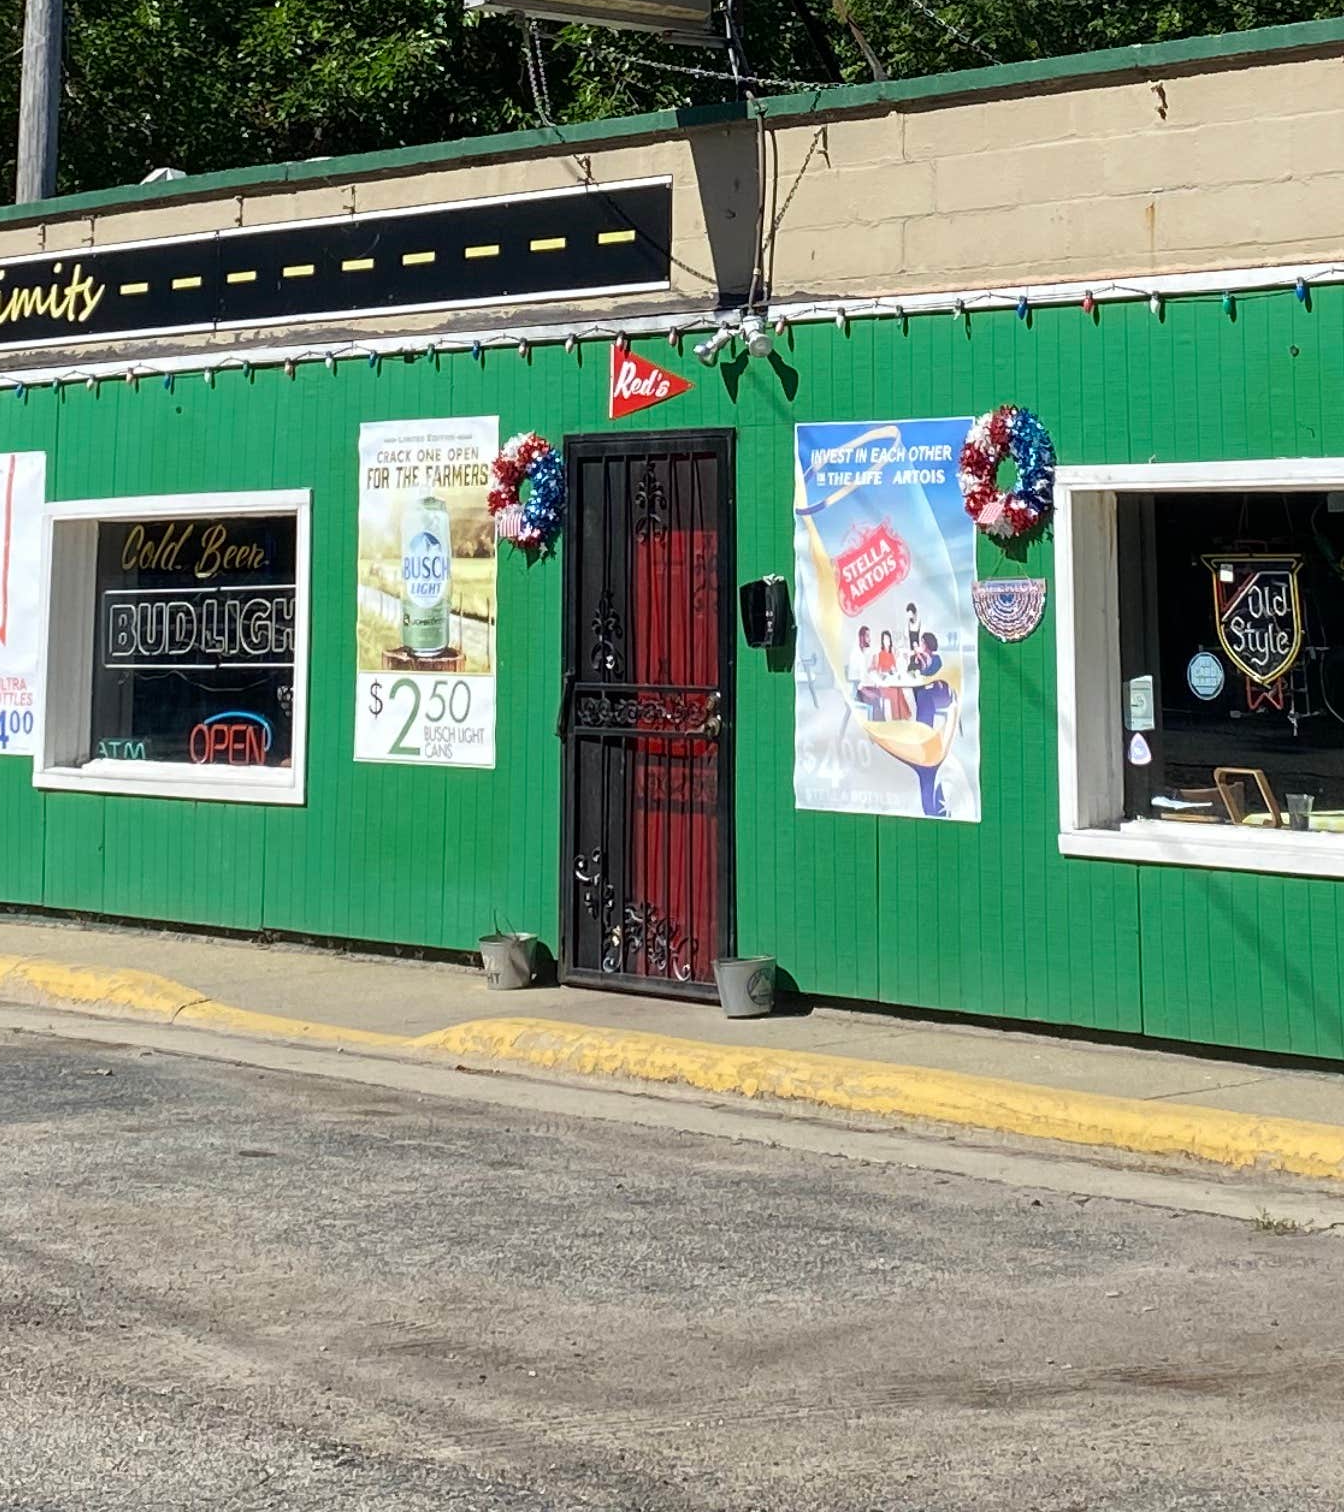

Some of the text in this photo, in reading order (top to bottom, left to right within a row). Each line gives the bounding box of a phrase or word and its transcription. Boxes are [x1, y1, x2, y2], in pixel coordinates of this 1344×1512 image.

[614, 361, 671, 400] Red's
[377, 447, 479, 463] CRACK ONE OPEN
[811, 445, 952, 464] INVEST IN EACH OTHER
[367, 463, 489, 489] FOR THE FARMERS
[828, 472, 852, 485] THE
[855, 471, 883, 485] LIFE
[892, 469, 945, 485] ARTOIS
[121, 523, 269, 578] Cold Beer
[842, 539, 891, 583] STELLA
[403, 556, 450, 581] BUSCH
[850, 554, 897, 600] ARTOIS
[411, 582, 441, 595] LIGHT
[1249, 578, 1288, 620] Old
[109, 601, 197, 656] BUD
[1229, 616, 1289, 665] Style
[189, 723, 265, 766] OPEN
[424, 726, 485, 744] BUSCH LIGHT
[98, 740, 146, 761] ATM
[424, 742, 453, 759] CANS
